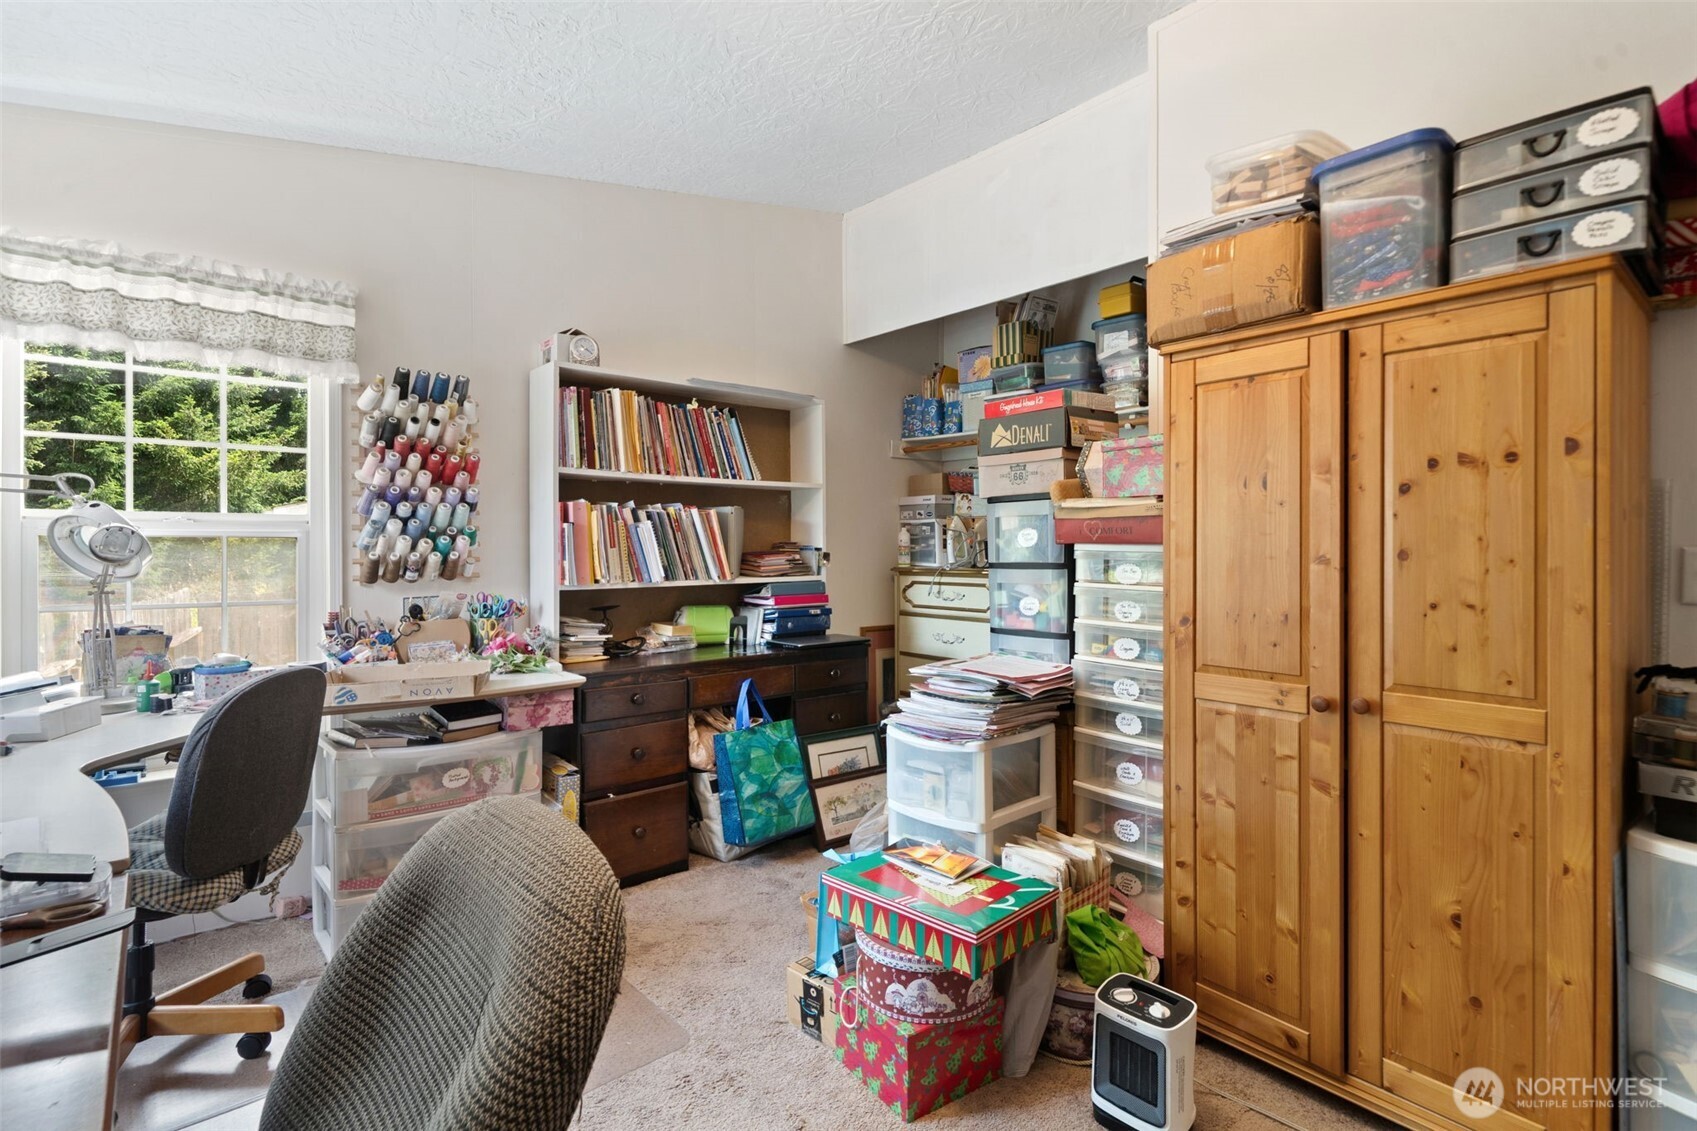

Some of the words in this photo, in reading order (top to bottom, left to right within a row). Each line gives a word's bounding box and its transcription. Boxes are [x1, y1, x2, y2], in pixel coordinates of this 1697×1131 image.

[1011, 423, 1049, 446] DENALI
[1089, 526, 1134, 536] COMFORT
[409, 686, 454, 697] AVON
